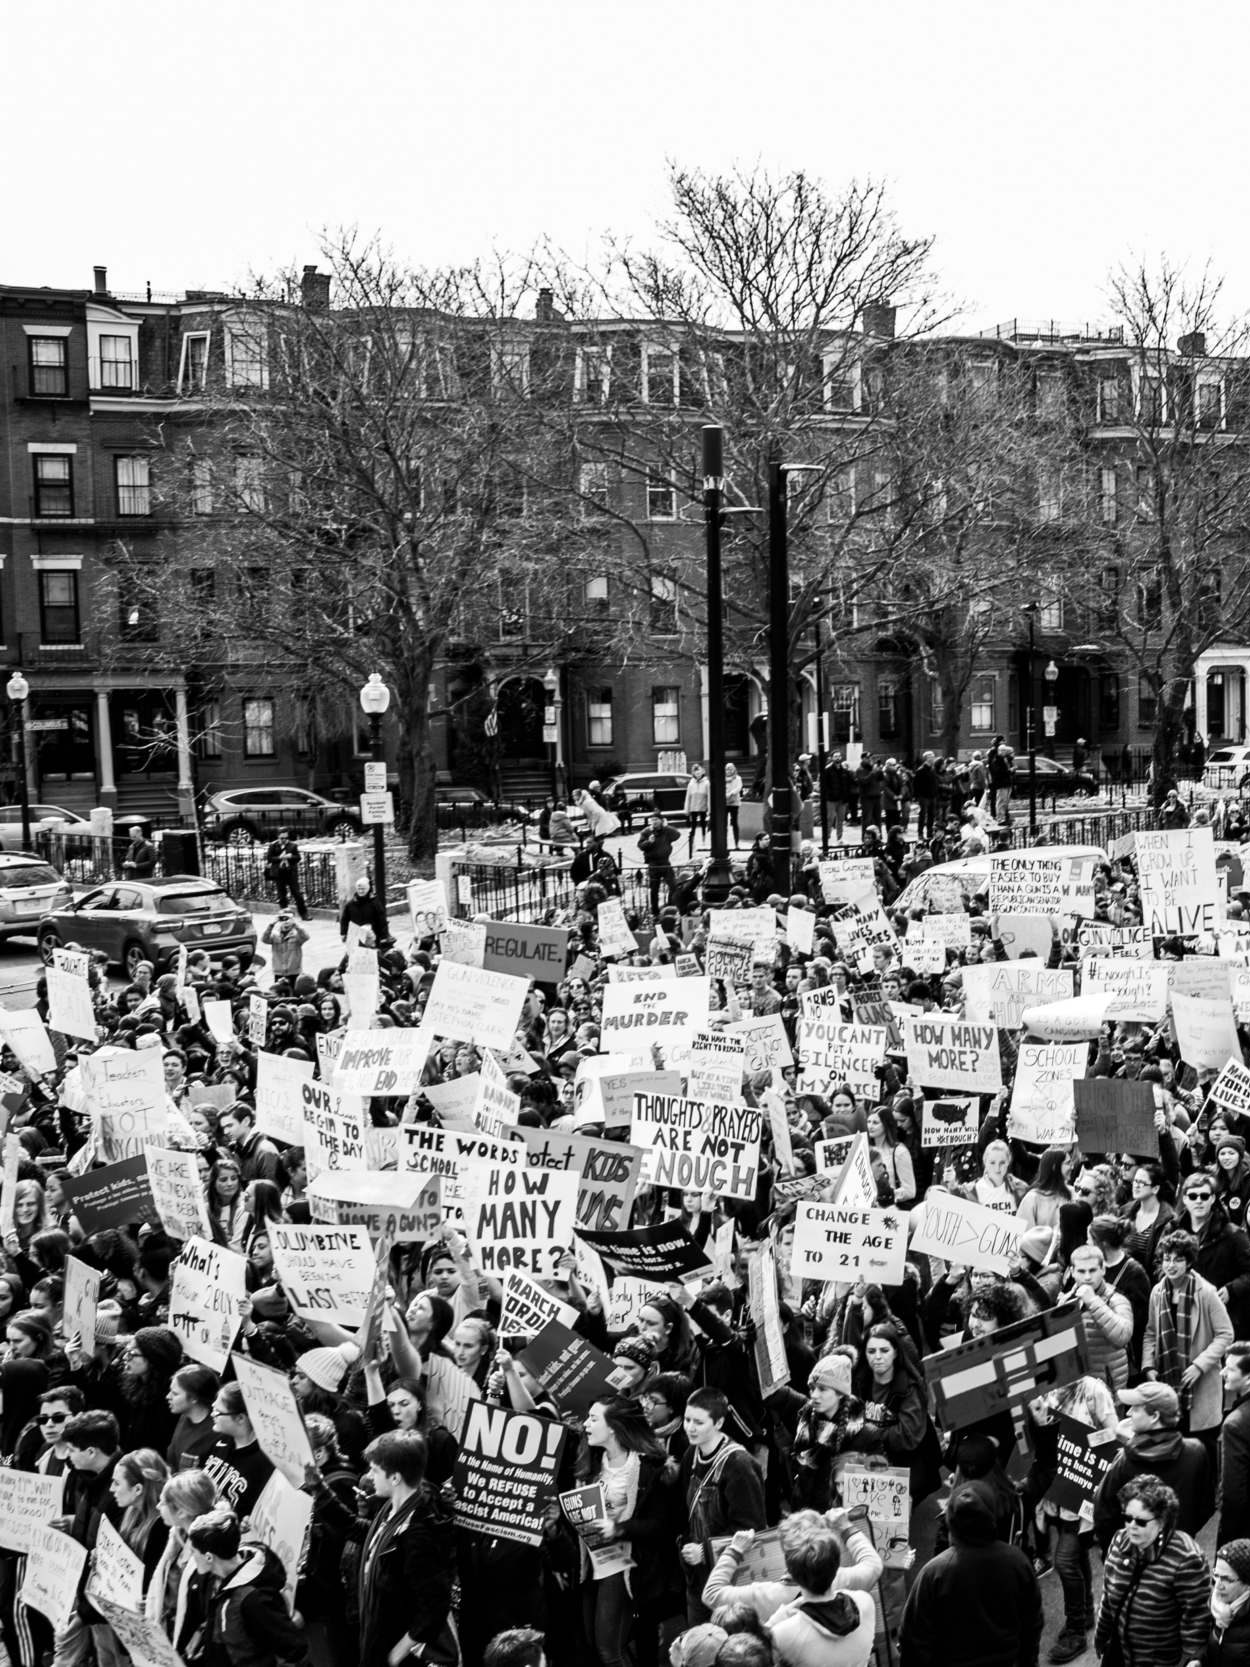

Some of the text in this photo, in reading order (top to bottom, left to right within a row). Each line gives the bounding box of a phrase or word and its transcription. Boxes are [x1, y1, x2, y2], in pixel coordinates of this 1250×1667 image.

[1137, 835, 1169, 850] WHEN
[990, 859, 1062, 871] THE ONLY THING
[1140, 854, 1172, 872] GROW
[991, 872, 1060, 883] EASIER TO BUY
[1142, 869, 1198, 890] I WANT
[991, 885, 1014, 894] THAN
[1144, 890, 1177, 906] TO BE
[838, 905, 862, 921] HOW
[856, 909, 881, 928] MANY
[1151, 903, 1215, 935] ALIVE
[848, 925, 873, 943] LIVES
[865, 929, 892, 946] DOES
[486, 934, 564, 964] REGULATE.
[707, 951, 745, 967] POLICY
[1112, 945, 1140, 958] FEELS
[447, 966, 517, 990] GUN VIOLENCE
[707, 965, 750, 982] CHANGE
[1087, 962, 1135, 987] #Enough
[991, 972, 1073, 999] ARMS
[53, 992, 91, 1026] AGAIN
[633, 992, 668, 1004] END
[428, 1010, 507, 1038] STEPHON CLARK
[603, 1010, 689, 1030] MURDER
[804, 1023, 836, 1040] YOU
[912, 1024, 994, 1050] HOW MANY
[339, 1047, 393, 1070] IMPROVE
[800, 1050, 879, 1073] SILENCER
[926, 1050, 980, 1072] MORE?
[1024, 1048, 1081, 1068] SCHOOL
[373, 1070, 398, 1091] END
[800, 1078, 831, 1093] MY
[829, 1070, 847, 1082] ON
[1036, 1070, 1073, 1083] ZONES
[98, 1087, 144, 1108] Educators
[301, 1083, 332, 1114] OUR
[1212, 1086, 1247, 1109] LIVES
[100, 1106, 155, 1132] NOT
[266, 1111, 296, 1134] CHANGE
[302, 1105, 361, 1140] BEGIN TO
[636, 1092, 702, 1131] THOUGHTS
[712, 1104, 761, 1144] PRAYERS
[317, 1129, 364, 1159] THE DAY
[403, 1128, 519, 1164] THE WORDS
[652, 1127, 746, 1163] ARE NOT
[406, 1151, 460, 1175] SCHOOL
[582, 1146, 634, 1184] KIDS
[488, 1169, 550, 1196] HOW
[476, 1199, 562, 1241] MANY
[806, 1208, 871, 1226] CHANGE
[824, 1230, 893, 1250] THE AGE
[921, 1204, 1024, 1257] YOUTH GUNS
[610, 1239, 690, 1255] time is now.
[179, 1243, 221, 1281] What's
[284, 1253, 356, 1269] SHOULD HAVE
[480, 1245, 571, 1278] MORE?
[804, 1250, 861, 1267] TO 21
[289, 1287, 339, 1311] LAST
[507, 1272, 562, 1320] MARCH
[463, 1402, 563, 1469] NO!
[1063, 1456, 1093, 1477] es hora.
[1084, 1448, 1097, 1465] is
[458, 1452, 553, 1485] In the Name of Humanity,
[1063, 1468, 1093, 1489] kounye
[467, 1472, 537, 1498] We REFUSE
[463, 1486, 535, 1512] to Accept a
[563, 1494, 583, 1511] GUNS
[454, 1499, 544, 1530] ascist America!
